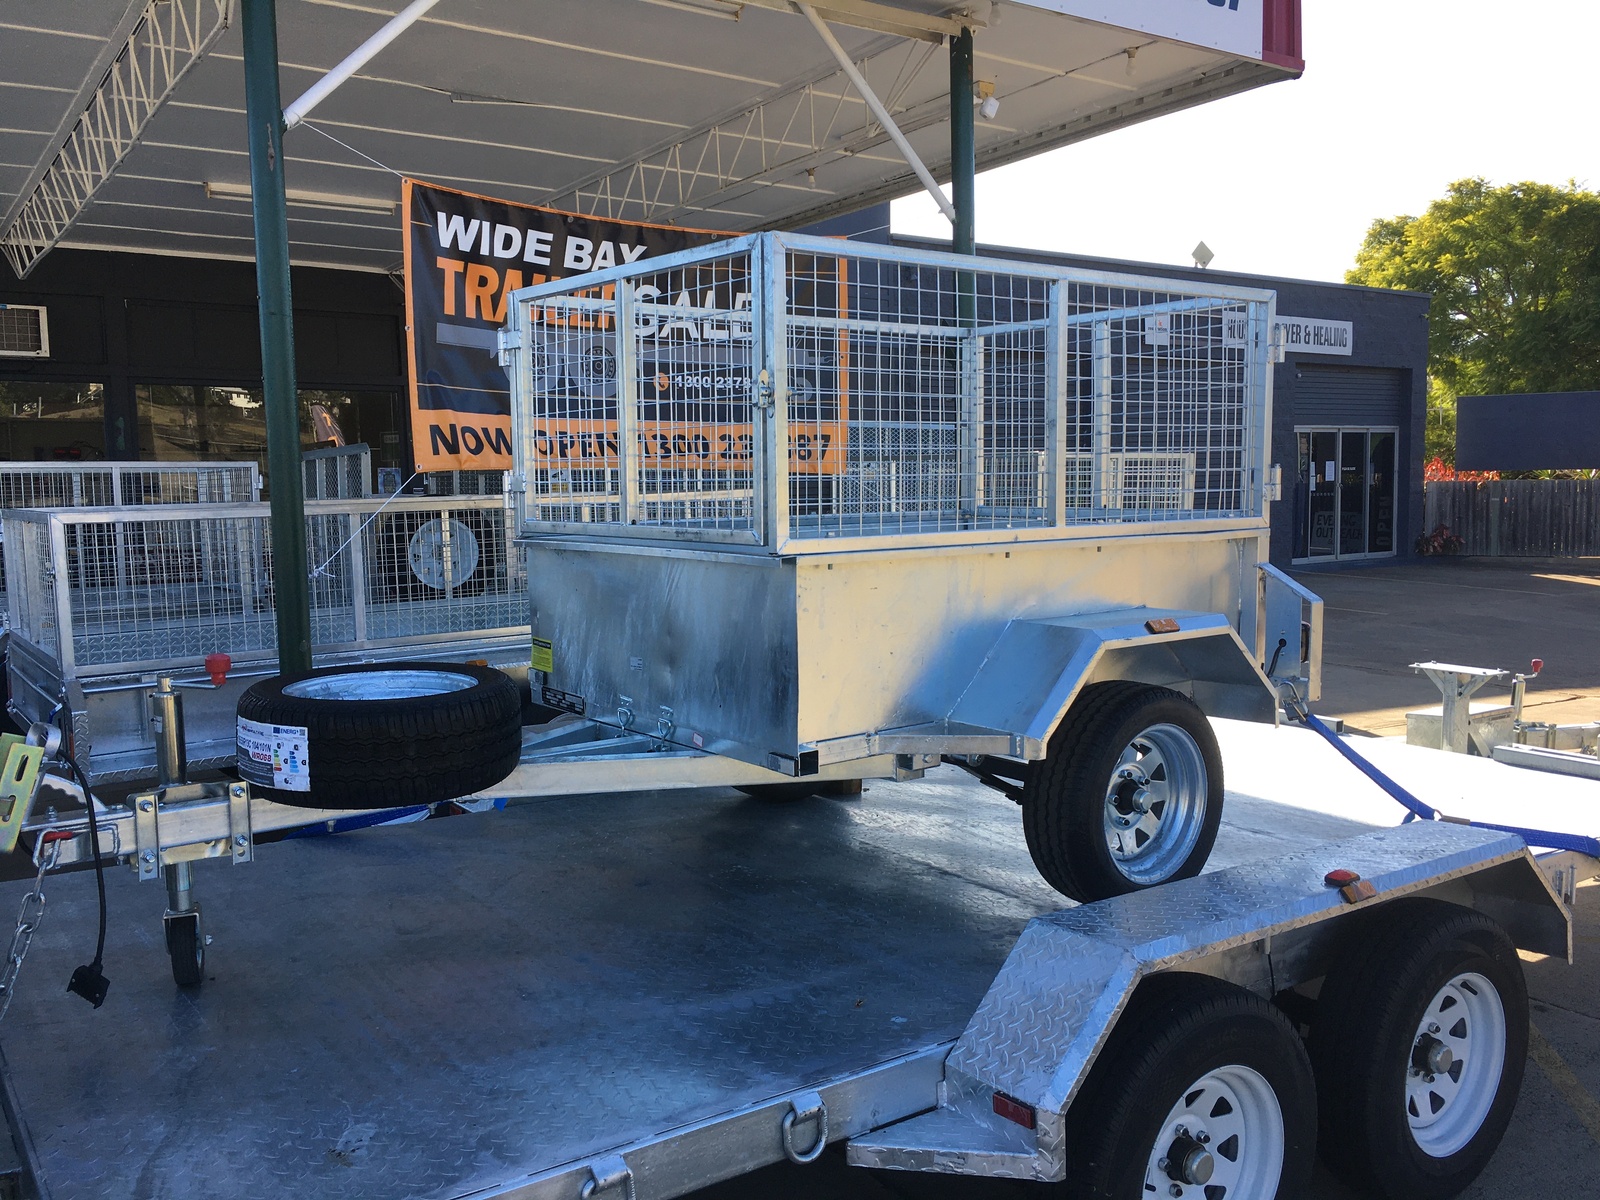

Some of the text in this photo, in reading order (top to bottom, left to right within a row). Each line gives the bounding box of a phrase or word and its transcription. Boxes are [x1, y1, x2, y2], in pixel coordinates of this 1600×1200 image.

[437, 211, 648, 272] WIDE BAY
[634, 284, 790, 342] SALE
[1304, 325, 1311, 344] &
[1313, 325, 1347, 347] HEALING
[429, 423, 831, 461] NOW OPEN 1300 2387
[1316, 527, 1363, 540] OUTEACH
[1317, 514, 1356, 527] EVENG
